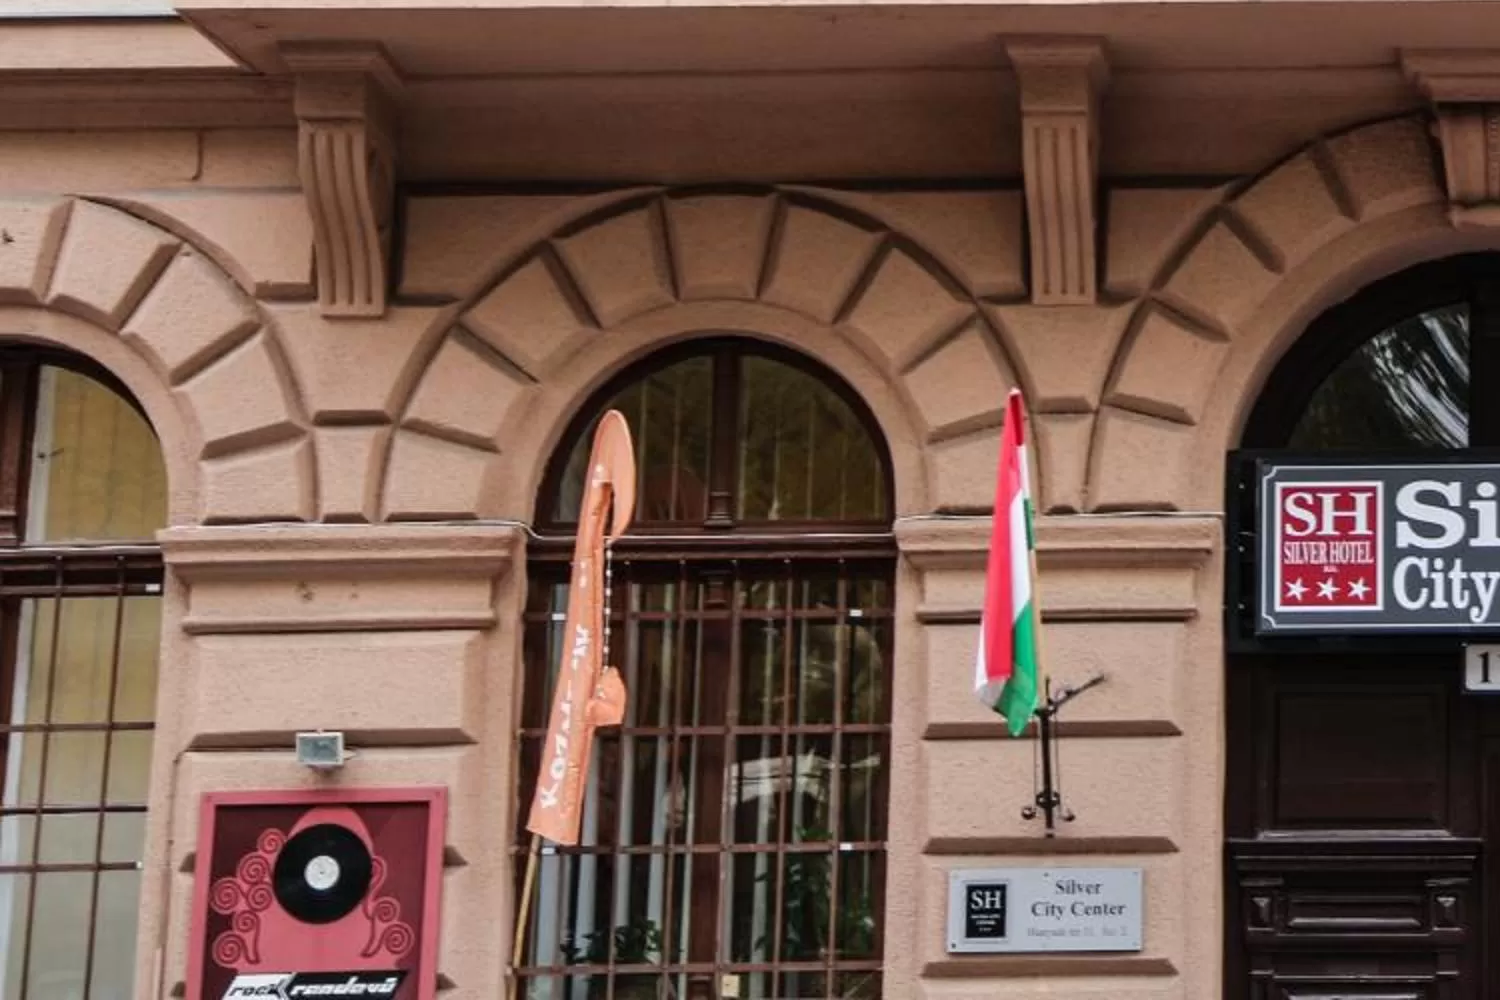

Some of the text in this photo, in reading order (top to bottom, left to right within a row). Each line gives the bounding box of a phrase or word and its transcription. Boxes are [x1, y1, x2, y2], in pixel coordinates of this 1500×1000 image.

[1284, 491, 1374, 536] SH
[1283, 541, 1374, 564] SILVER HOTEL
[1055, 880, 1103, 895] Silver
[971, 890, 1001, 909] SH
[1031, 901, 1127, 920] City Center
